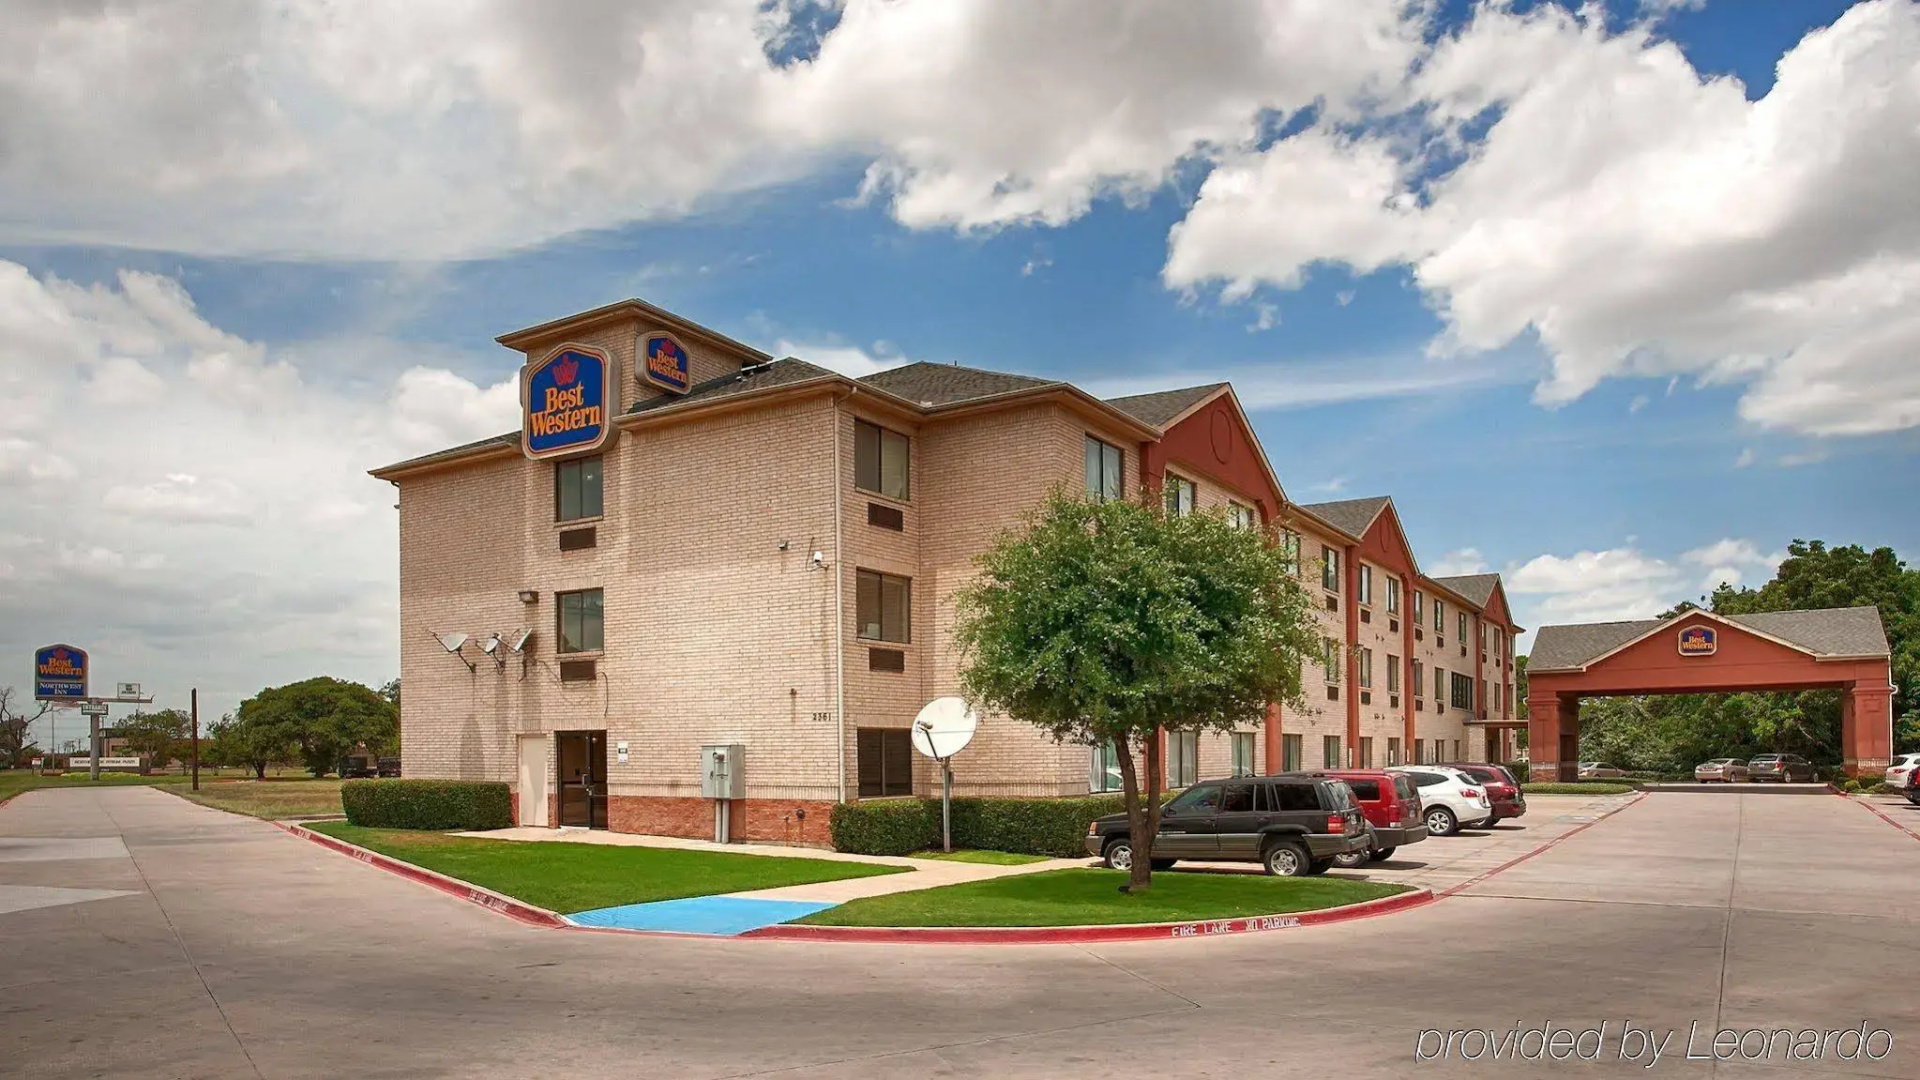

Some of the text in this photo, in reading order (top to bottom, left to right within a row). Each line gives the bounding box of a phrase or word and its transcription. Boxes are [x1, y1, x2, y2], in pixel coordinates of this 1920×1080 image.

[657, 349, 679, 369] Best
[647, 356, 687, 382] Western
[545, 381, 584, 413] Best
[531, 405, 601, 437] Western
[1682, 641, 1712, 649] Western
[39, 664, 82, 675] Western
[48, 657, 72, 667] Best
[39, 682, 82, 690] NORTHWEST
[1171, 923, 1198, 938] FIRE
[1203, 921, 1233, 935] LANE
